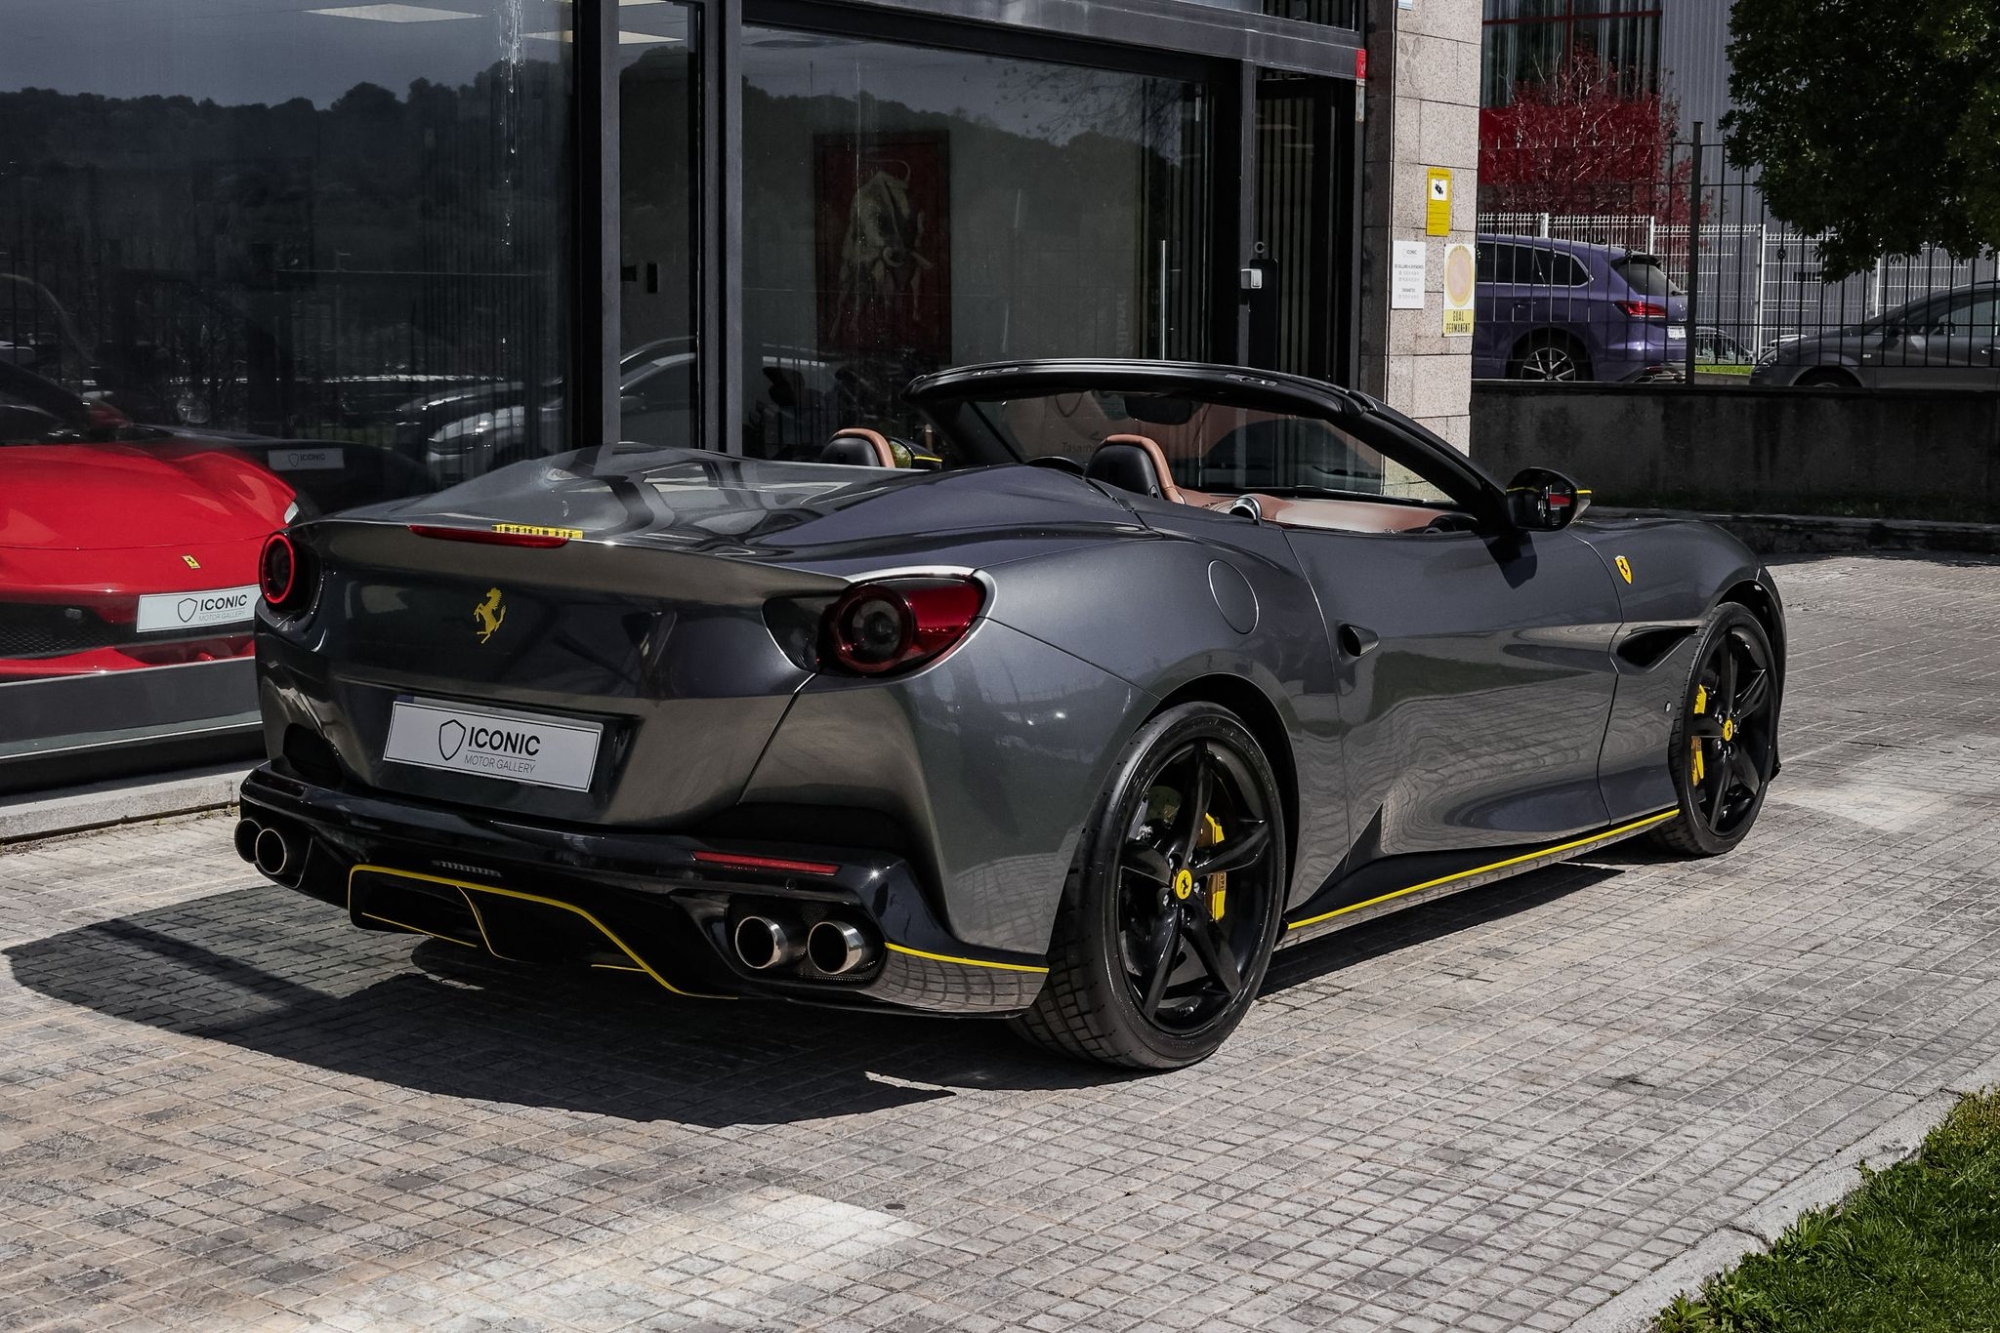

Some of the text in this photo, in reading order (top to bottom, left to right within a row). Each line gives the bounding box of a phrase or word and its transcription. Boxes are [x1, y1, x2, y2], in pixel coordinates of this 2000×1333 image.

[1445, 322, 1471, 333] PERMANENT
[300, 453, 325, 461] ICONIC
[200, 594, 248, 612] ICONIC
[199, 613, 220, 621] MOTOR
[221, 610, 245, 619] GALLERY
[468, 726, 541, 756] ICONIC
[464, 754, 495, 768] MOTOR
[496, 758, 536, 774] GALLERY
